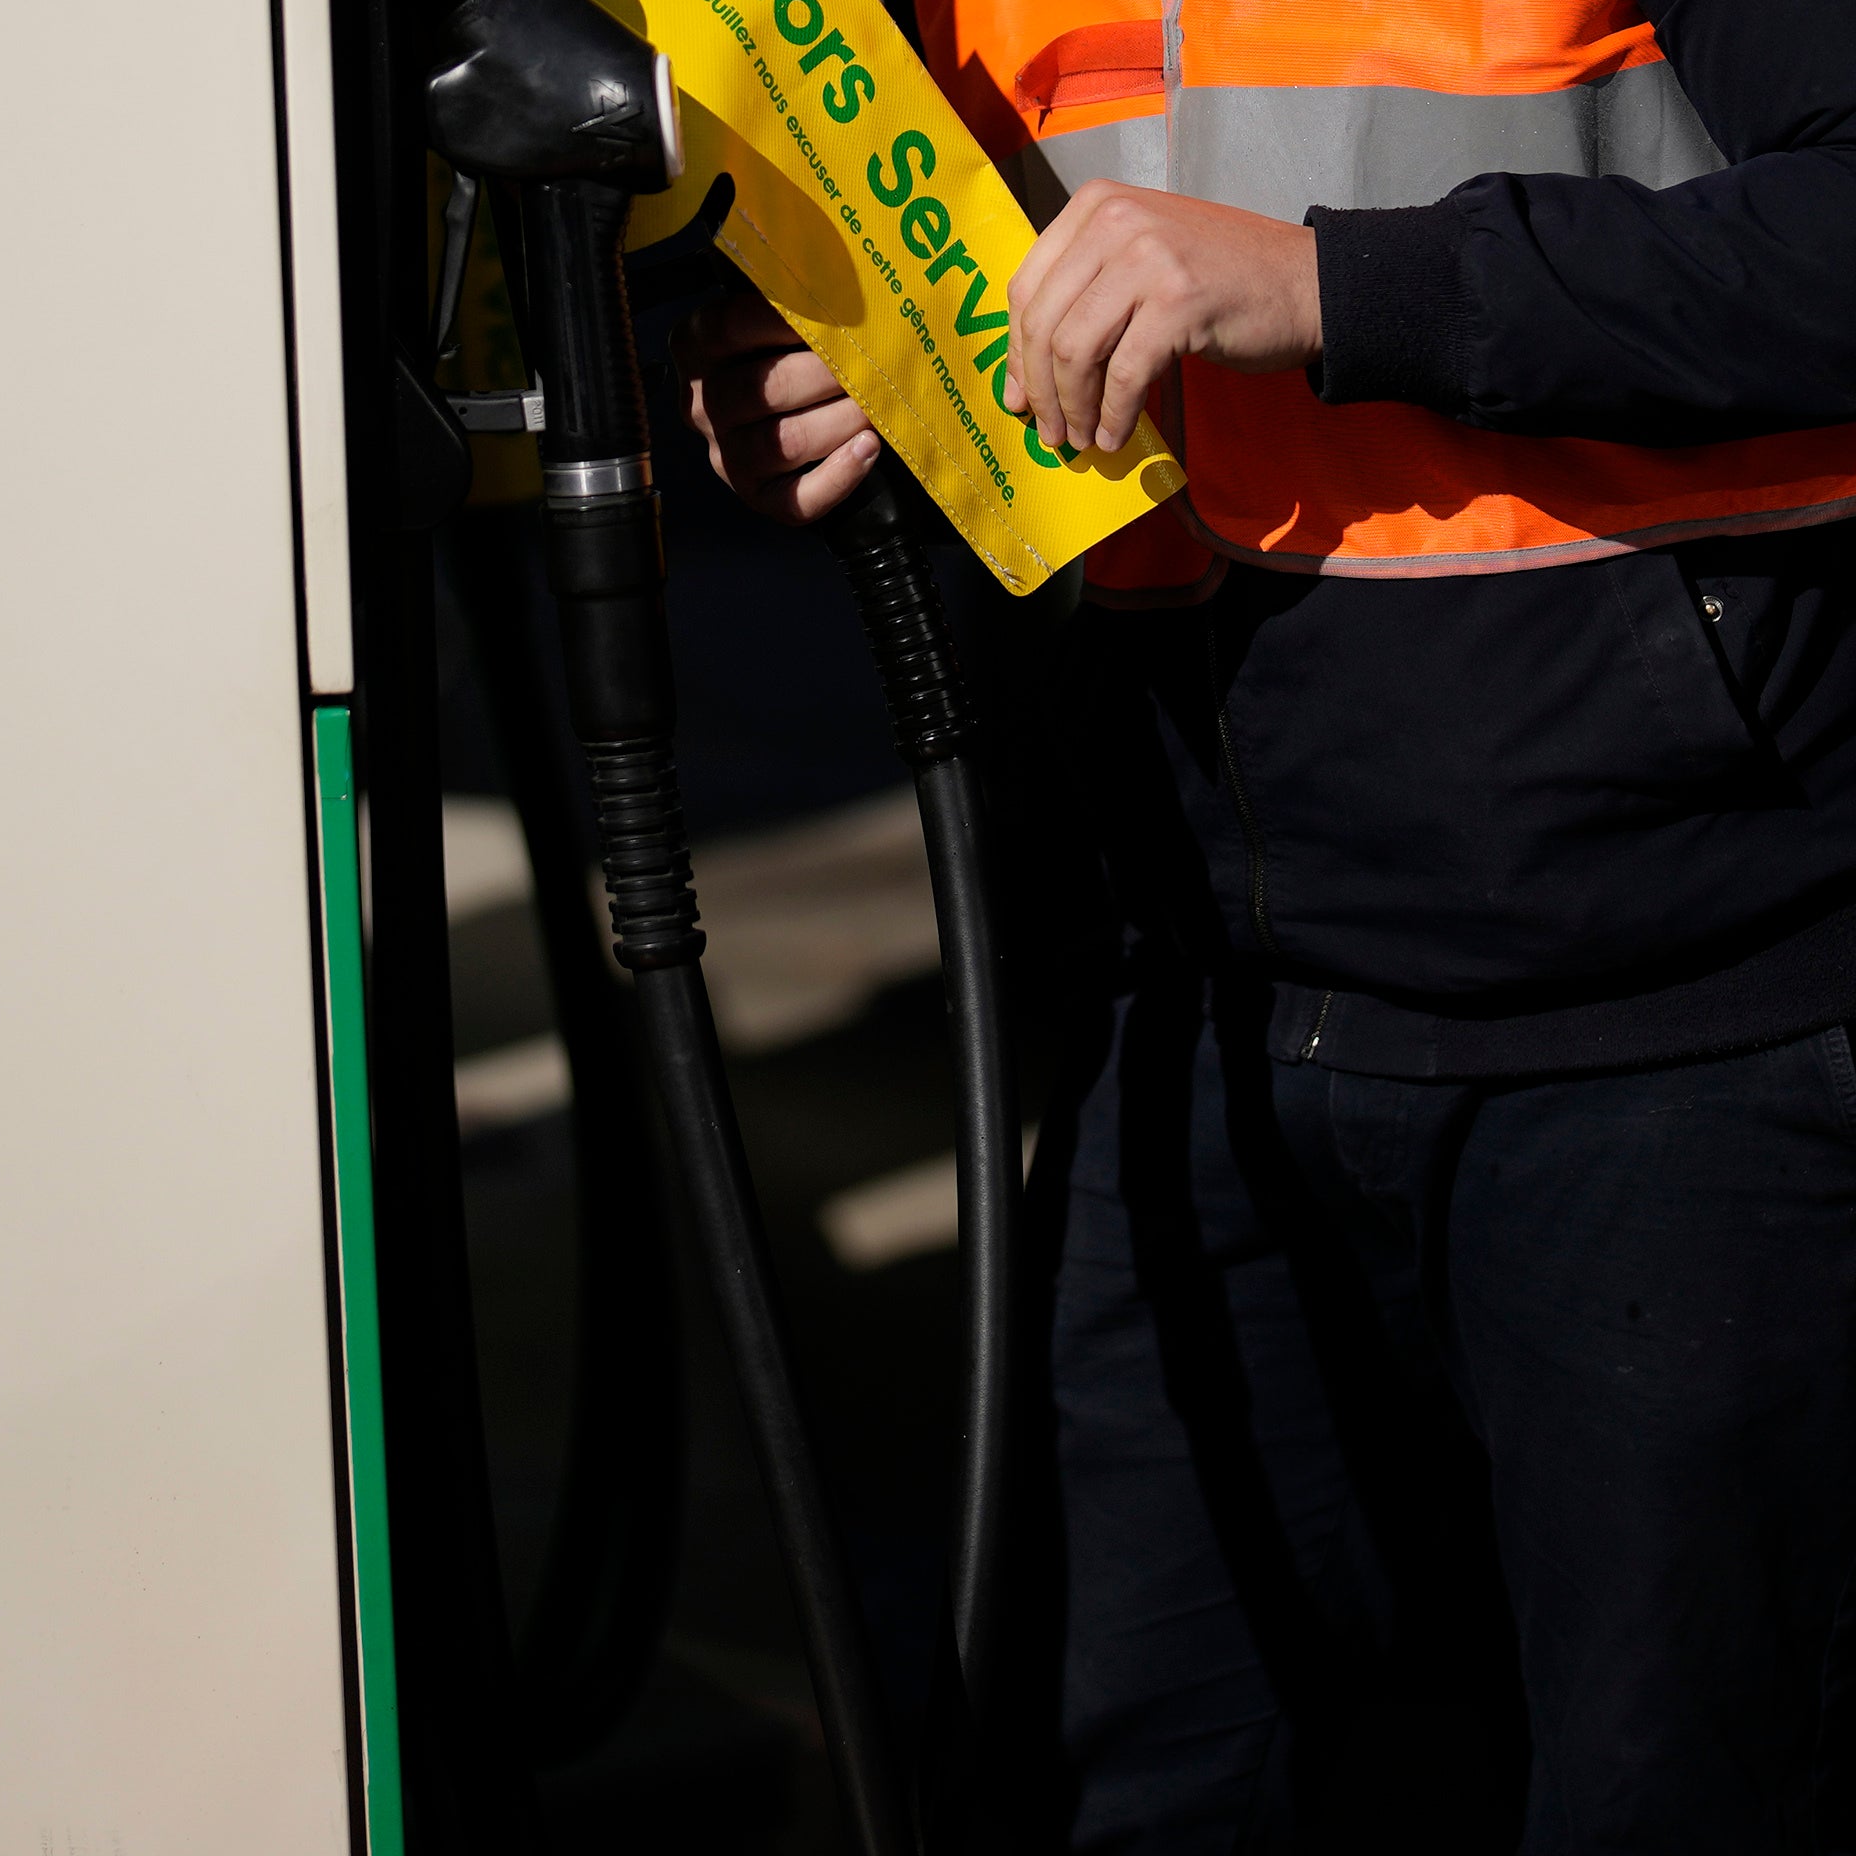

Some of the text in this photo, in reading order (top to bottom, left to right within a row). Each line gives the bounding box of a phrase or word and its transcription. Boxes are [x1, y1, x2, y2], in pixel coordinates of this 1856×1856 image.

[753, 57, 788, 114] nous
[786, 115, 843, 201] excuser
[840, 204, 862, 235] de
[861, 237, 903, 295] cette
[899, 297, 936, 355] gêne
[931, 354, 1015, 509] momentanée.
